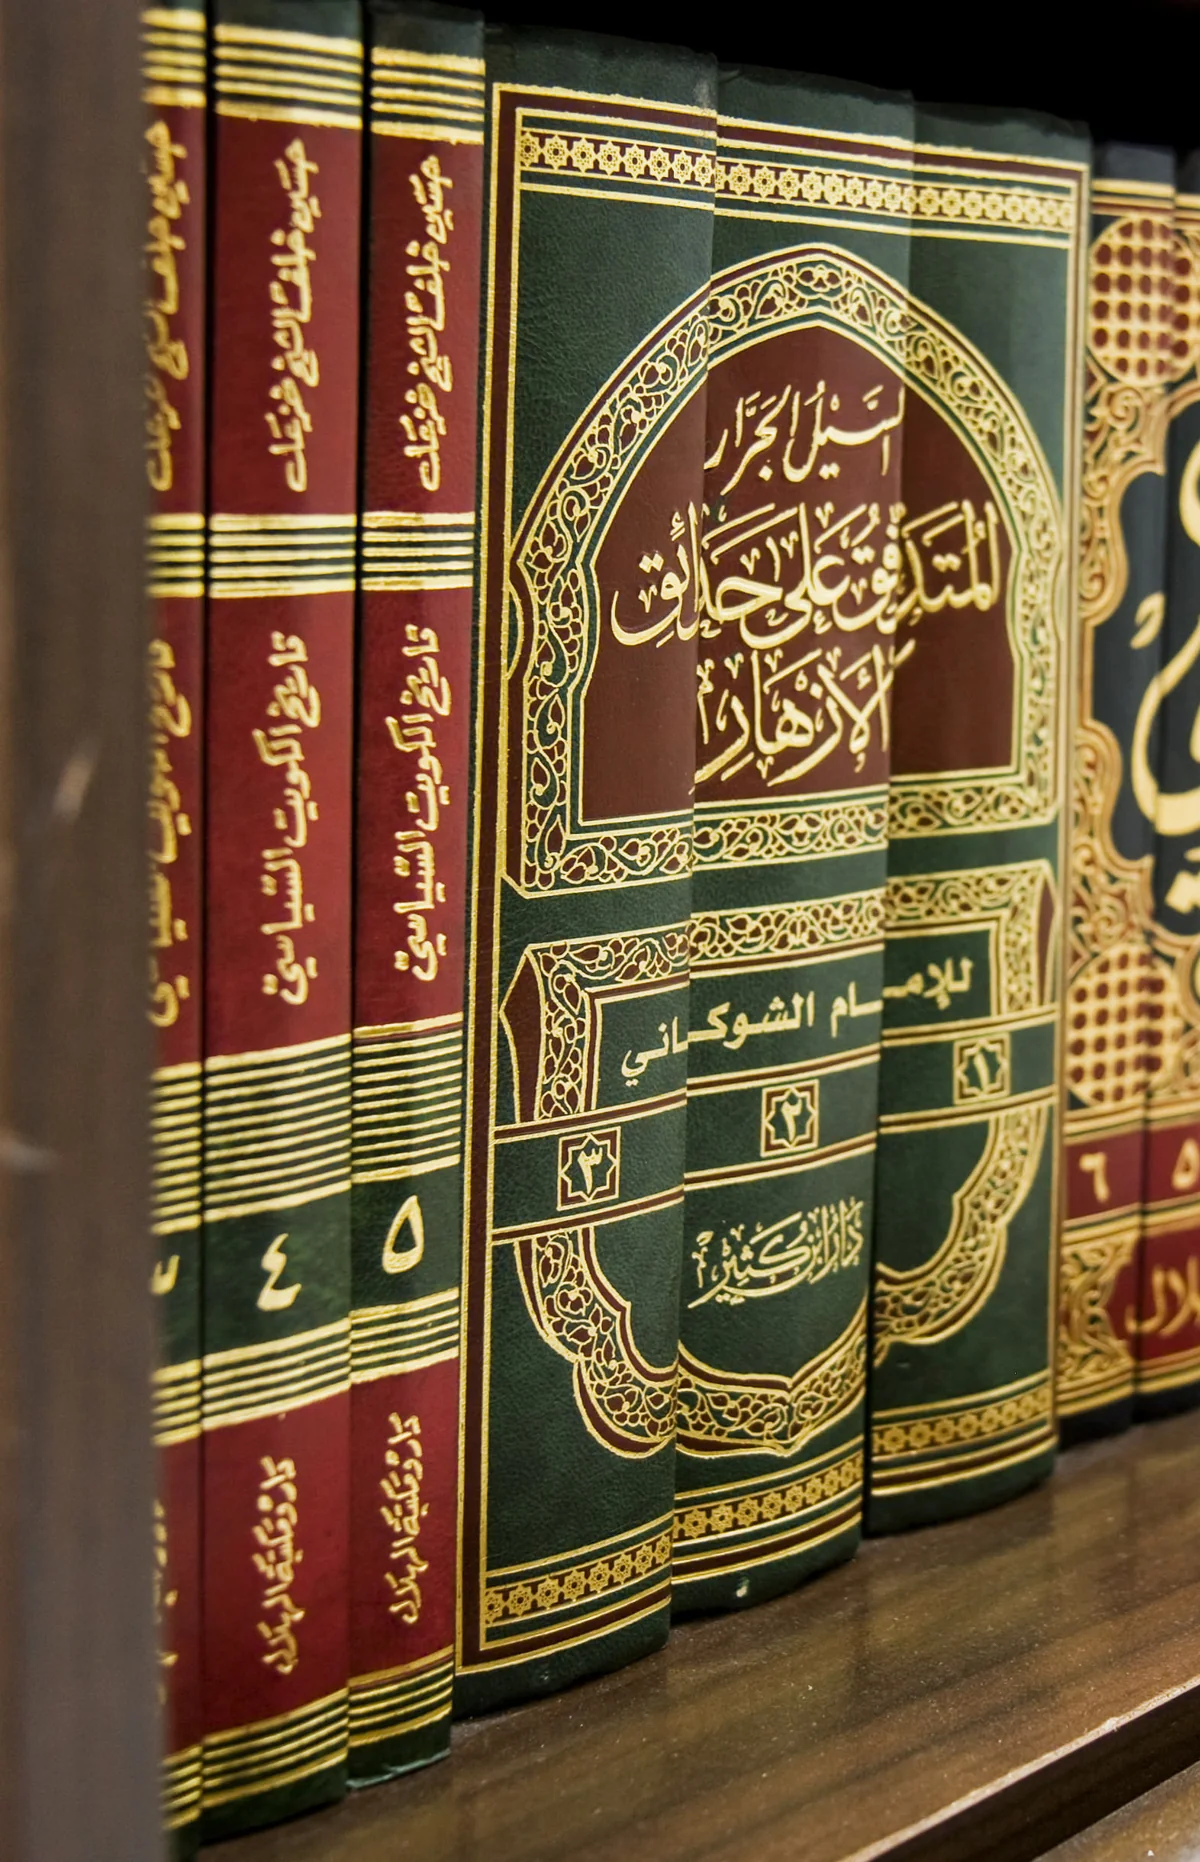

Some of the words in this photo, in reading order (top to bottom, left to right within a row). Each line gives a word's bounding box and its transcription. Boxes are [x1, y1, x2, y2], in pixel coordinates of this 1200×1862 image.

[268, 631, 320, 727] تاريخ
[399, 624, 451, 716] تاريخ
[252, 725, 318, 848] الكويت
[386, 713, 450, 830] الكويت
[393, 829, 446, 982] السياسي
[620, 991, 816, 1087] الشوكاني
[976, 1046, 990, 1083] ١
[578, 1150, 604, 1191] ٣
[1080, 1151, 1110, 1203] ٦
[1172, 1138, 1200, 1191] ٥
[257, 1232, 301, 1311] ٤
[382, 1195, 424, 1274] ٥
